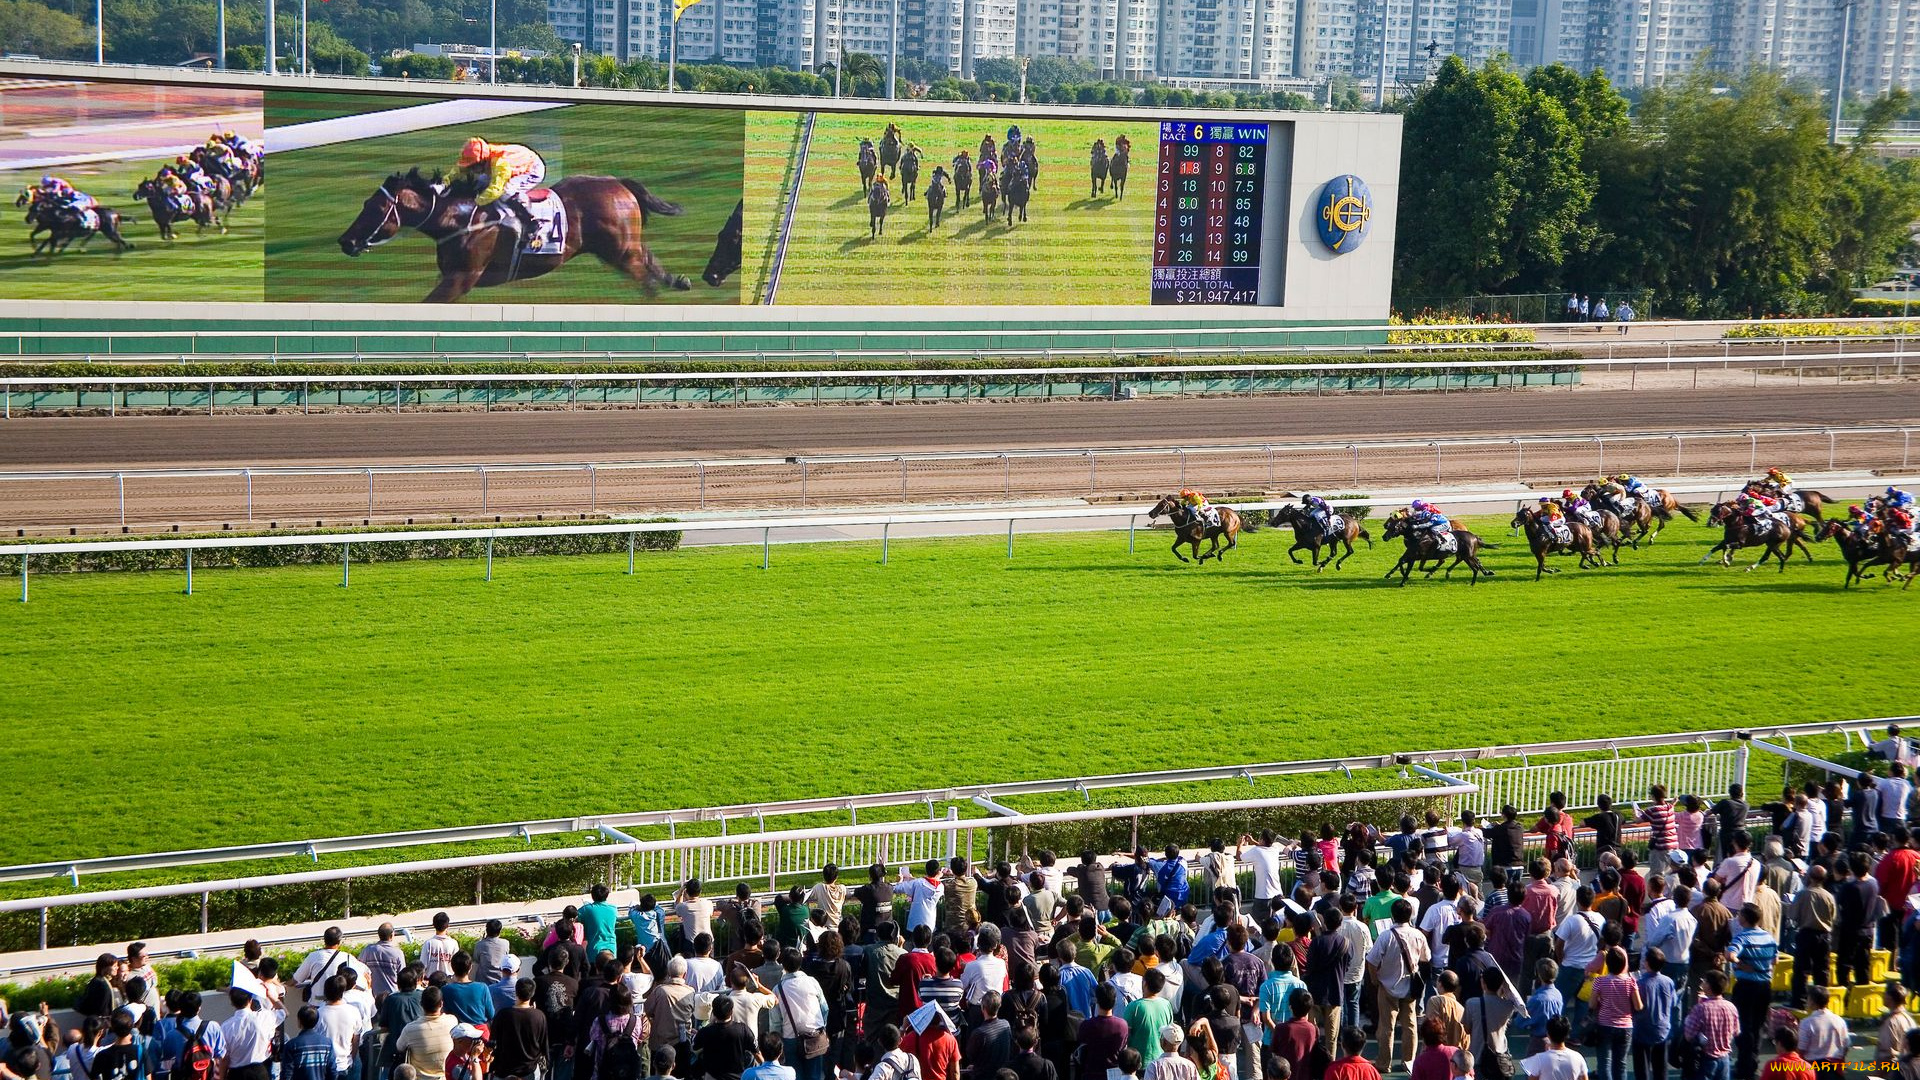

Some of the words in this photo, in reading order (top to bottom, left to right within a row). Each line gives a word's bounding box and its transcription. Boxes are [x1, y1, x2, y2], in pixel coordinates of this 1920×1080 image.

[1162, 133, 1186, 141] RACE
[1194, 124, 1204, 140] 6
[1238, 128, 1266, 140] WIN
[1163, 144, 1169, 156] 1
[1183, 144, 1199, 157] 99
[1215, 145, 1224, 158] 8
[1238, 146, 1254, 158] 82
[1161, 161, 1170, 174] 2
[1181, 162, 1200, 174] 1.8
[1215, 162, 1223, 175] 9
[1235, 163, 1255, 175] 6.8
[1161, 179, 1169, 192] 3
[1182, 180, 1197, 192] 18
[1211, 180, 1226, 192] 10
[1235, 180, 1254, 193] 7.5
[1159, 197, 1168, 209] 4
[1178, 197, 1198, 210] 8.0
[1210, 198, 1223, 210] 11
[1235, 198, 1251, 210] 85
[1159, 215, 1167, 227] 5
[1179, 215, 1193, 227] 91
[1209, 215, 1223, 227] 12
[1234, 215, 1250, 227] 48
[1158, 232, 1166, 245] 6
[1179, 232, 1193, 244] 14
[1208, 233, 1222, 245] 13
[1233, 233, 1247, 245] 31
[1158, 250, 1166, 262] 7
[1177, 250, 1193, 262] 26
[1207, 250, 1221, 262] 14
[1232, 250, 1248, 262] 99
[1153, 281, 1171, 289] WIN
[1174, 281, 1201, 289] POOL
[1204, 281, 1235, 290] TOTAL
[1176, 290, 1184, 303] $
[1188, 290, 1256, 304] 21,947,417
